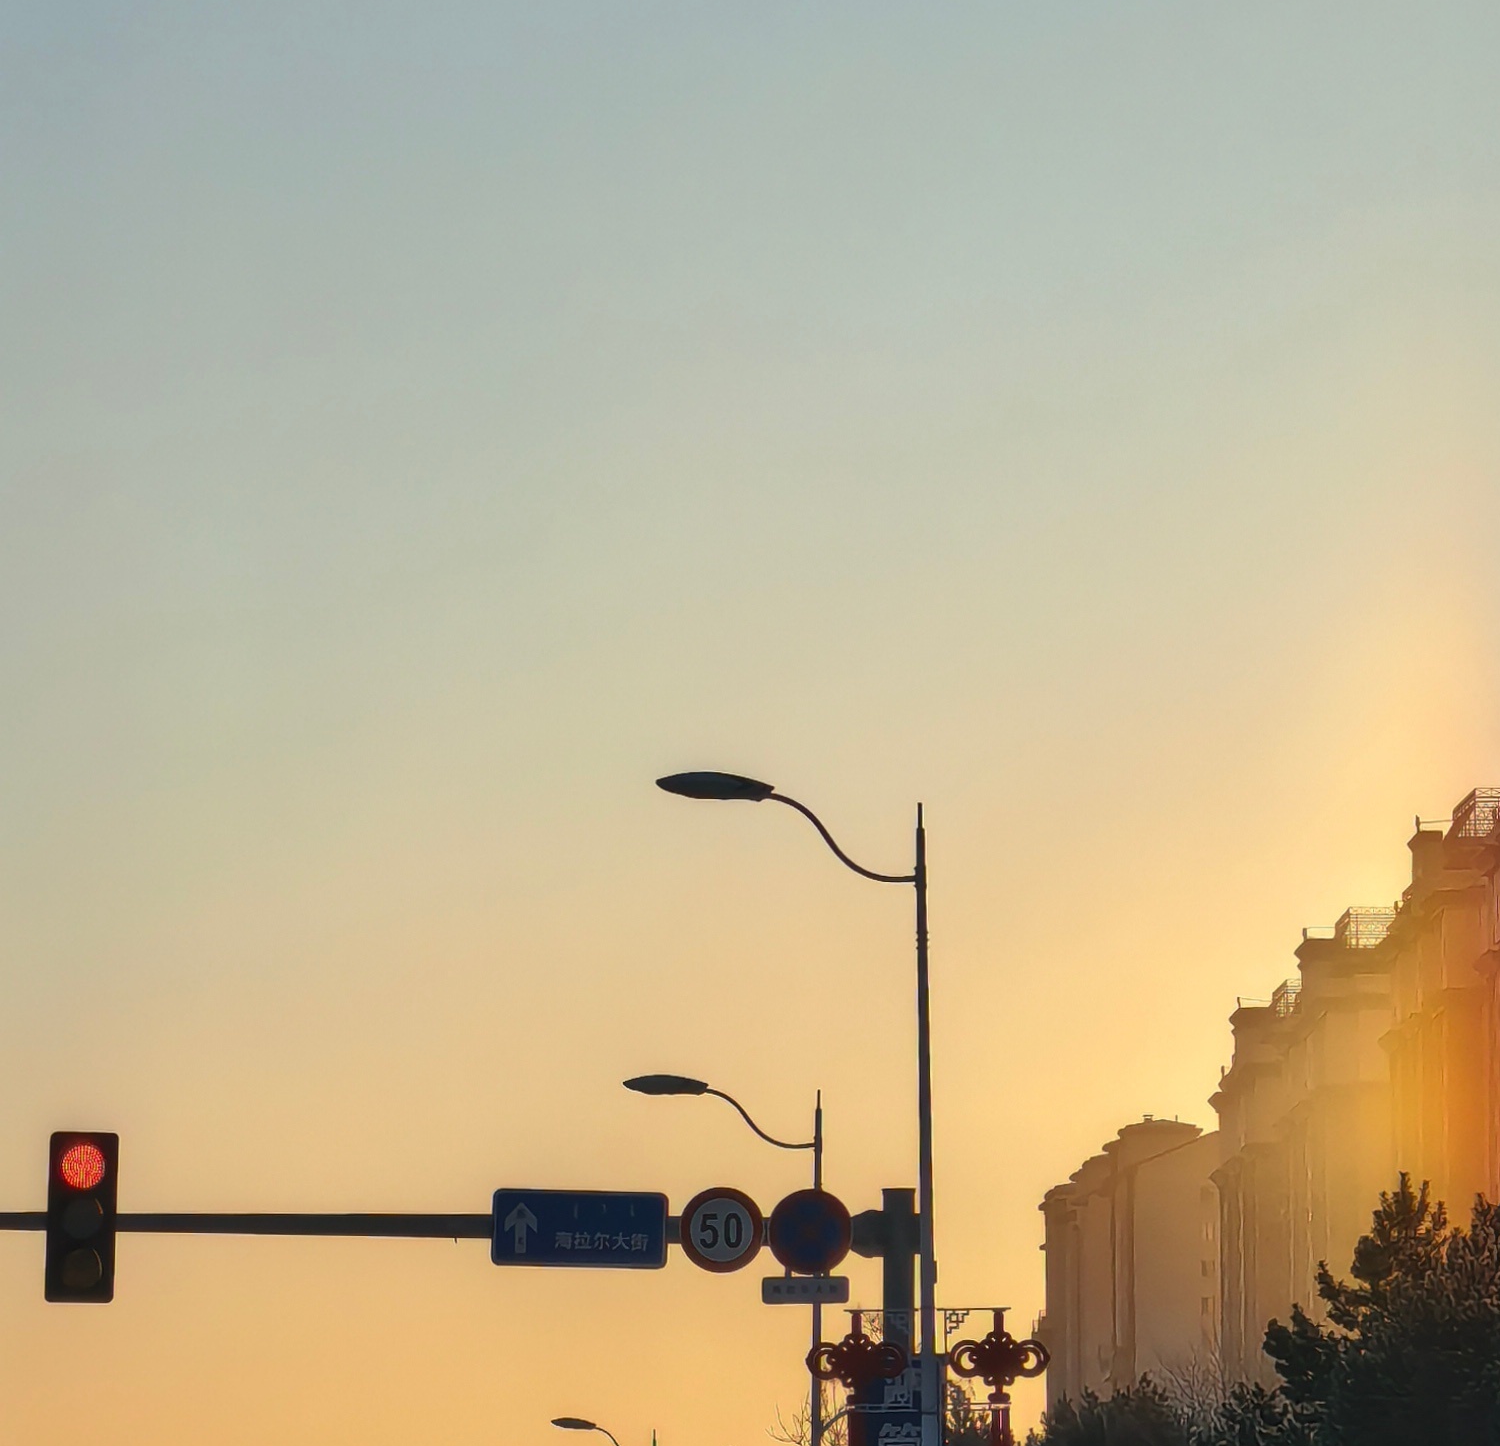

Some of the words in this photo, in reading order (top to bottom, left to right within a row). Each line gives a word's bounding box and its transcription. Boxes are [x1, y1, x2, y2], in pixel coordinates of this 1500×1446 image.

[555, 1231, 648, 1251] 海拉尔大街
[700, 1213, 743, 1249] 50
